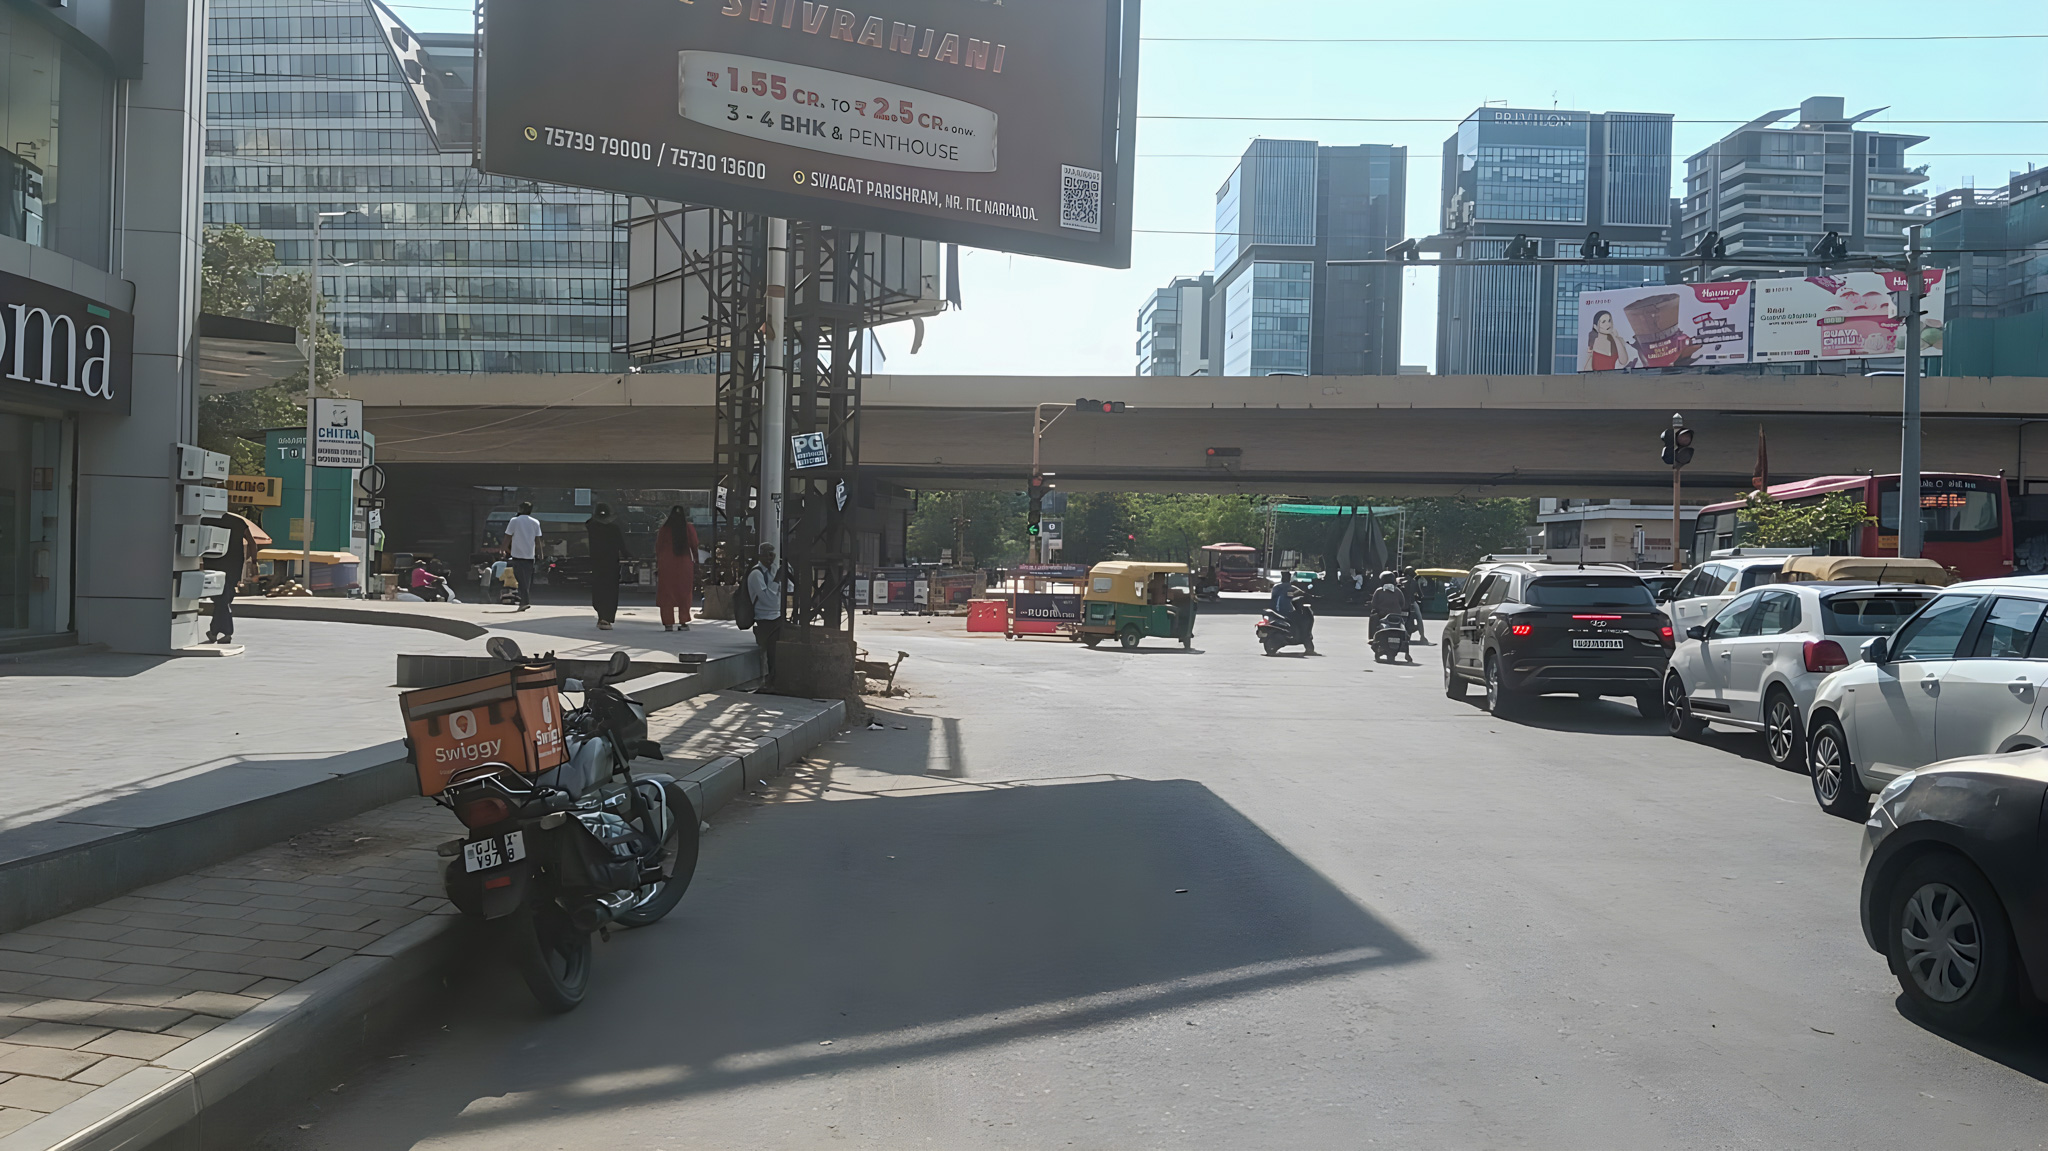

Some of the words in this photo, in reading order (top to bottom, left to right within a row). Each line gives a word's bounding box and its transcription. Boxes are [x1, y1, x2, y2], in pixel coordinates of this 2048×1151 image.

[721, 0, 1006, 73] SHIVRANJANI
[831, 98, 850, 113] TO
[544, 127, 595, 152] 75739
[599, 136, 651, 161] 79000
[670, 148, 716, 172] 75730
[720, 157, 767, 179] 13600
[780, 114, 826, 138] BHK
[831, 126, 843, 141] &
[849, 128, 959, 162] PENTHOUSE
[810, 171, 864, 195] SWAGAT
[866, 181, 942, 209] PARISHRAM,
[0, 303, 115, 400] ma
[318, 427, 360, 440] CHITRA
[794, 435, 823, 453] PG
[435, 738, 502, 762] Swiggy
